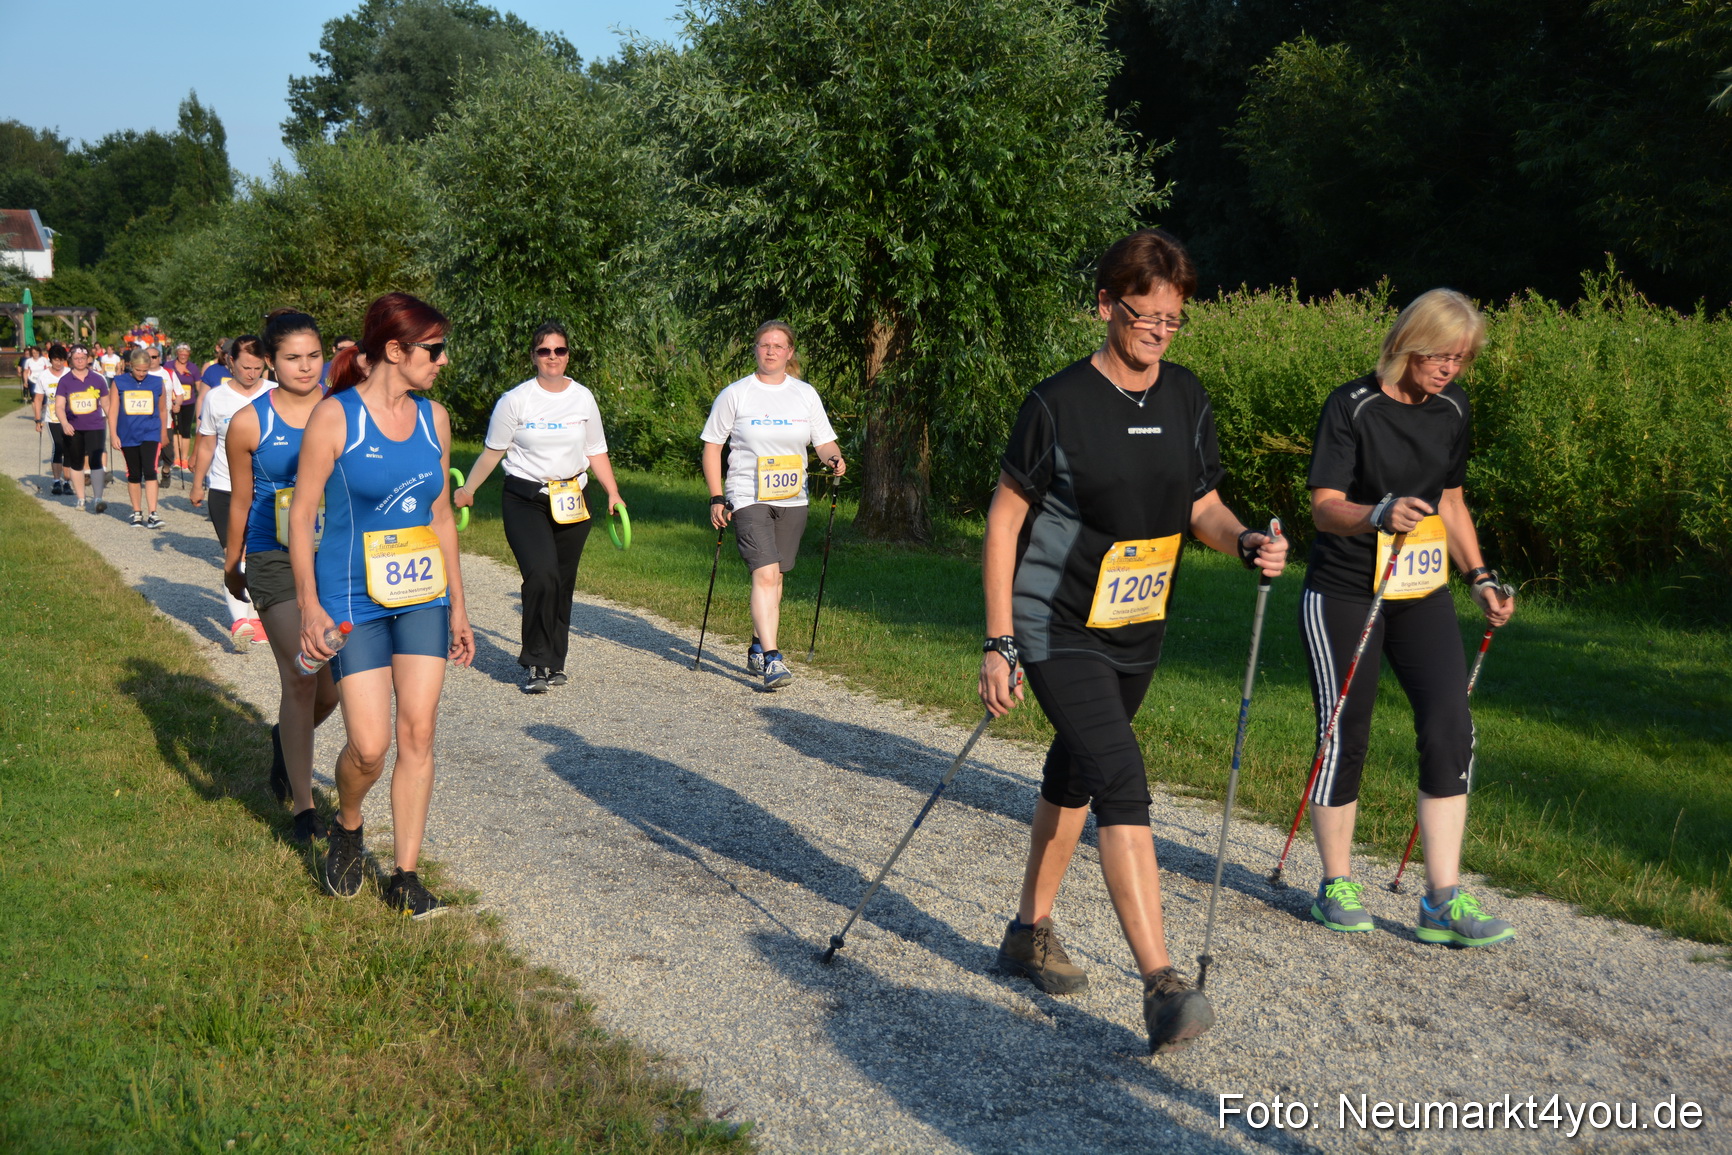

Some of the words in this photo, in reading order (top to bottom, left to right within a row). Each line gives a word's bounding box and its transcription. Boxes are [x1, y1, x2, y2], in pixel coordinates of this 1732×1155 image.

[75, 400, 92, 408] 704
[130, 400, 148, 408] 747
[764, 472, 798, 488] 1309
[374, 494, 394, 512] Team
[393, 477, 418, 494] Schick
[418, 471, 433, 480] Bau
[557, 494, 584, 511] 131
[386, 556, 434, 586] 842
[1108, 571, 1167, 604] 1205
